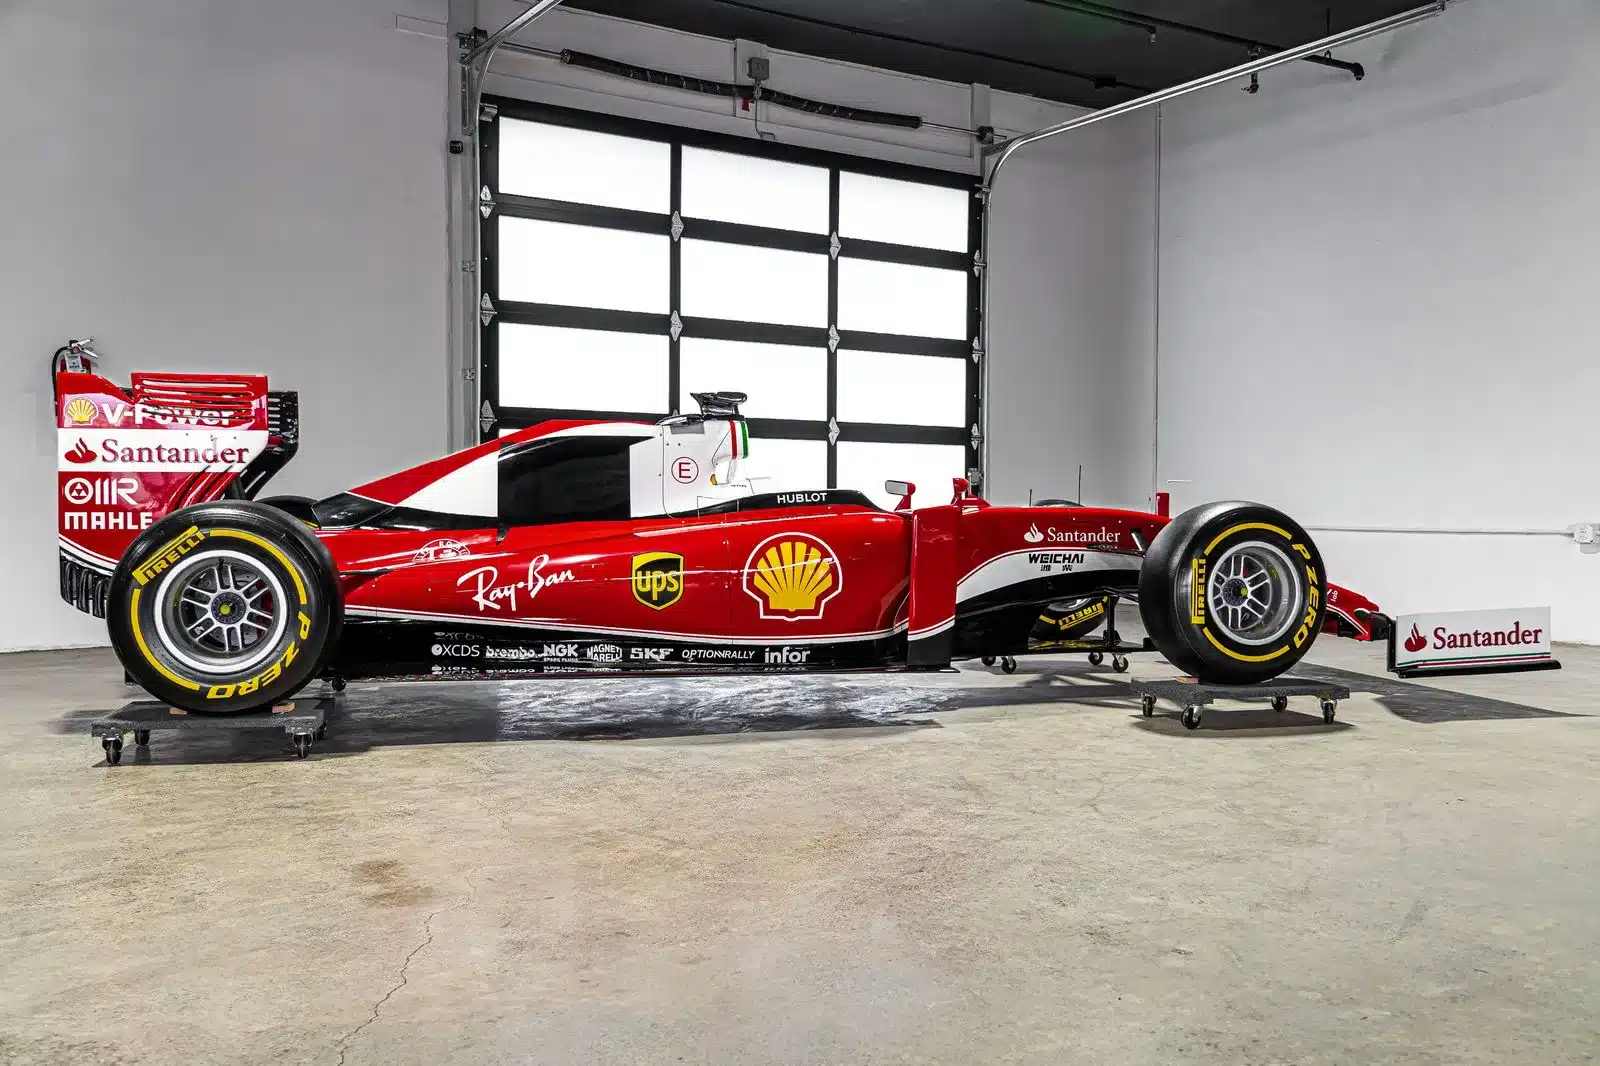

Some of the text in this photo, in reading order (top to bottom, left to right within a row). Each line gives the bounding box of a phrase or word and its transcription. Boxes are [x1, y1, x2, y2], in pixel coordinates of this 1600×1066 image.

[101, 438, 250, 464] Santander
[678, 462, 691, 479] E
[777, 493, 828, 504] HUBLOT
[64, 511, 153, 530] MAHLE
[1047, 526, 1121, 543] Santander
[132, 525, 206, 586] PIRELLI
[1028, 553, 1085, 564] WEICHAI
[456, 554, 576, 612] Ray-Ban
[636, 569, 680, 601] ups
[1191, 558, 1207, 625] PIRELLI
[1292, 543, 1319, 649] P ZERO
[1057, 601, 1105, 631] PIRELLI
[1432, 621, 1543, 650] Santander
[206, 610, 311, 700] P ZERO
[441, 644, 480, 657] XCDS
[485, 646, 536, 659] brembo
[543, 643, 579, 657] NGK
[629, 647, 674, 661] SKF
[764, 646, 811, 664] infor
